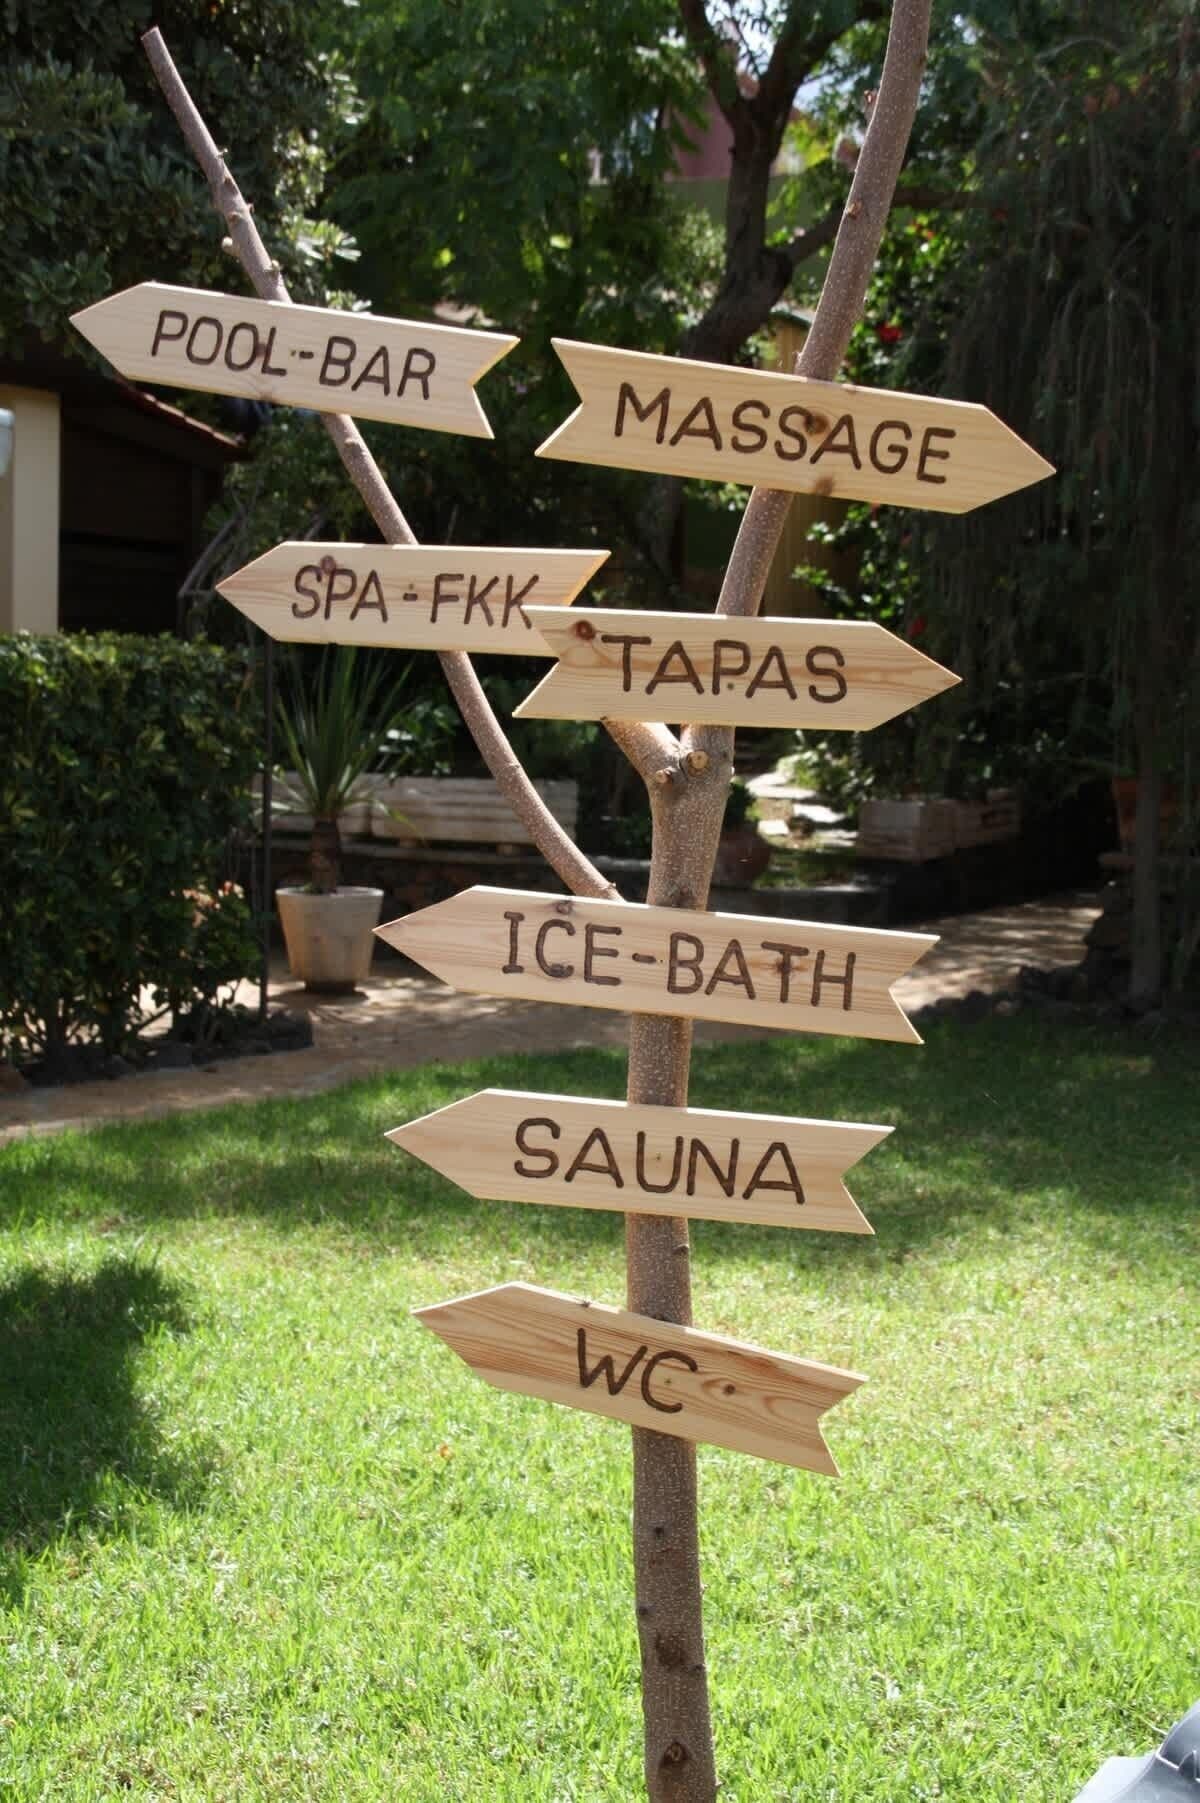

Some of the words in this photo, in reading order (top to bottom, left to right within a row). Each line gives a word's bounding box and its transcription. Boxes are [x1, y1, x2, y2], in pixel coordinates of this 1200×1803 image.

[150, 309, 436, 402] POOL-BAR
[614, 381, 957, 485] MASSAGE
[601, 634, 848, 705] TAPAS
[502, 910, 857, 1011] ICE-BATH
[513, 1116, 806, 1206] SAUNA
[576, 1327, 698, 1415] WC
